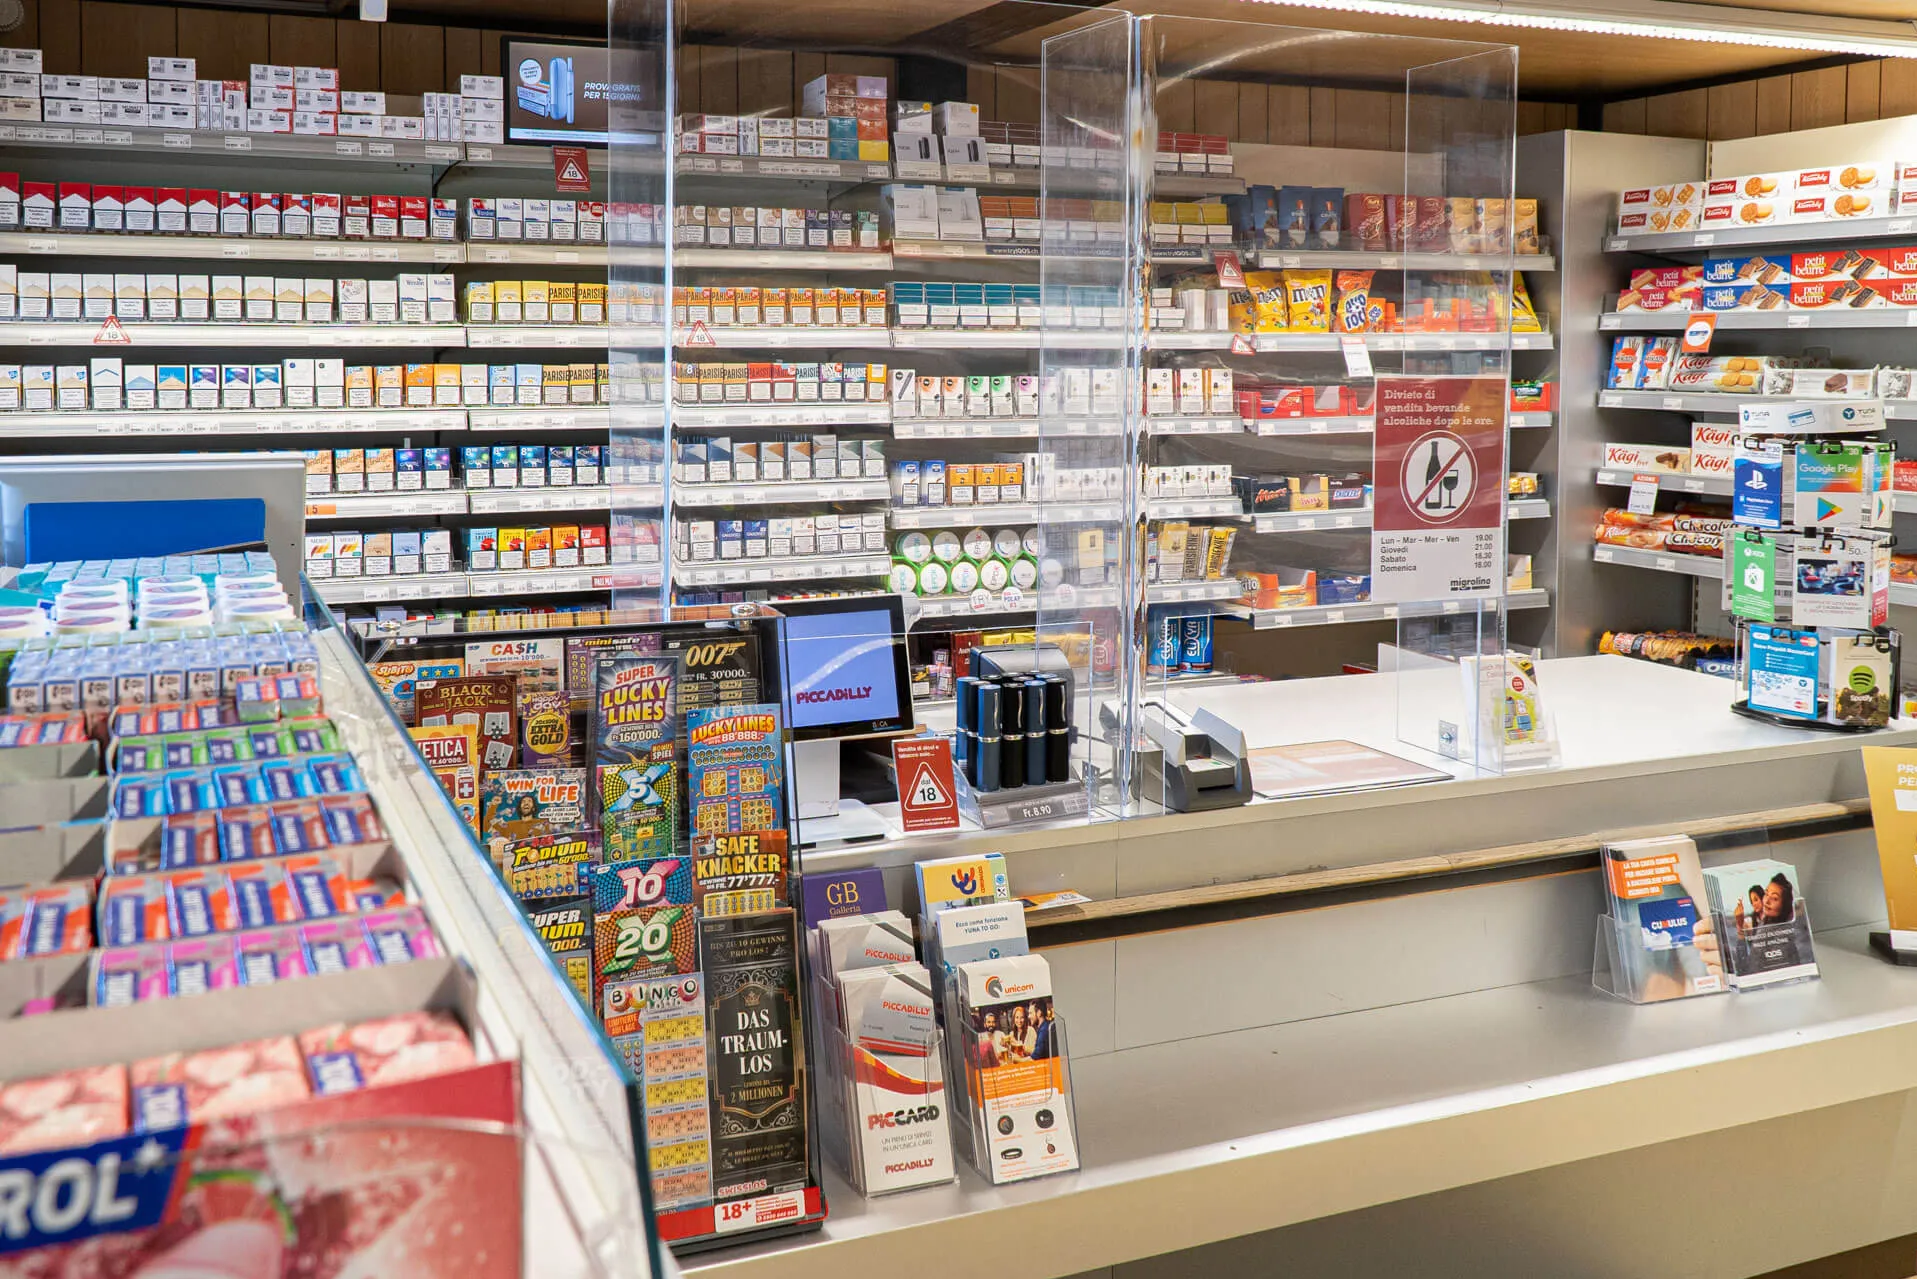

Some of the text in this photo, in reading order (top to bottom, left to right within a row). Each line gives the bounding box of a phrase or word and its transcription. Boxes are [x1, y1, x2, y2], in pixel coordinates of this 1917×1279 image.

[584, 92, 600, 100] PER
[567, 170, 578, 178] 18
[1805, 254, 1824, 268] petit
[1804, 283, 1824, 297] petit
[696, 334, 706, 342] 18
[1384, 390, 1436, 400] Divieto di
[1384, 403, 1470, 413] vendita bevande
[1384, 416, 1432, 426] alcoliche
[1434, 417, 1461, 429] dopo
[1463, 416, 1473, 426] le
[1696, 426, 1731, 445] Kägi
[1607, 448, 1641, 465] Kägi
[1694, 454, 1730, 472] Kägi
[1799, 463, 1858, 475] Google Play
[1381, 537, 1394, 545] Lun
[1475, 542, 1493, 550] 21.00
[1380, 555, 1407, 564] Sabato
[1380, 564, 1417, 573] Domenica
[1450, 577, 1491, 589] migrolino
[491, 642, 538, 655] CA$H
[685, 641, 731, 668] 007
[376, 664, 415, 677] SUBITO
[615, 665, 656, 685] SUPER
[696, 669, 751, 681] FR. 30'000.-
[440, 685, 494, 699] BLACK
[603, 678, 670, 710] LUCKY
[446, 696, 487, 712] JACK
[607, 702, 665, 725] LINES
[531, 724, 564, 735] EXTRA
[619, 730, 664, 742] 160'000.-
[690, 715, 776, 743] LUCKY LINES
[531, 733, 564, 746] GOLD
[721, 731, 765, 742] 88'888.-
[652, 750, 674, 761] SPIEL
[506, 776, 554, 792] WIN FOR
[629, 776, 651, 800] 5
[539, 785, 579, 803] LIFE
[919, 788, 937, 802] 18
[1034, 805, 1051, 816] 8.90
[716, 834, 760, 855] SAFE
[696, 853, 782, 879] KNACKER
[727, 874, 781, 889] 77'777.-
[623, 874, 666, 905] 10
[826, 881, 860, 905] GB
[1651, 917, 1688, 931] CUMULUS
[615, 922, 671, 959] 20
[750, 935, 786, 947] GEWINNE
[611, 978, 698, 1005] BINGO
[1004, 983, 1034, 994] unicorn
[736, 1008, 771, 1031] DAS
[720, 1028, 788, 1054] TRAUM-
[738, 1053, 773, 1076] LOS
[738, 1085, 785, 1101] MILLIONEN
[717, 1179, 768, 1198] SWISSLOS
[721, 1201, 753, 1221] 18+
